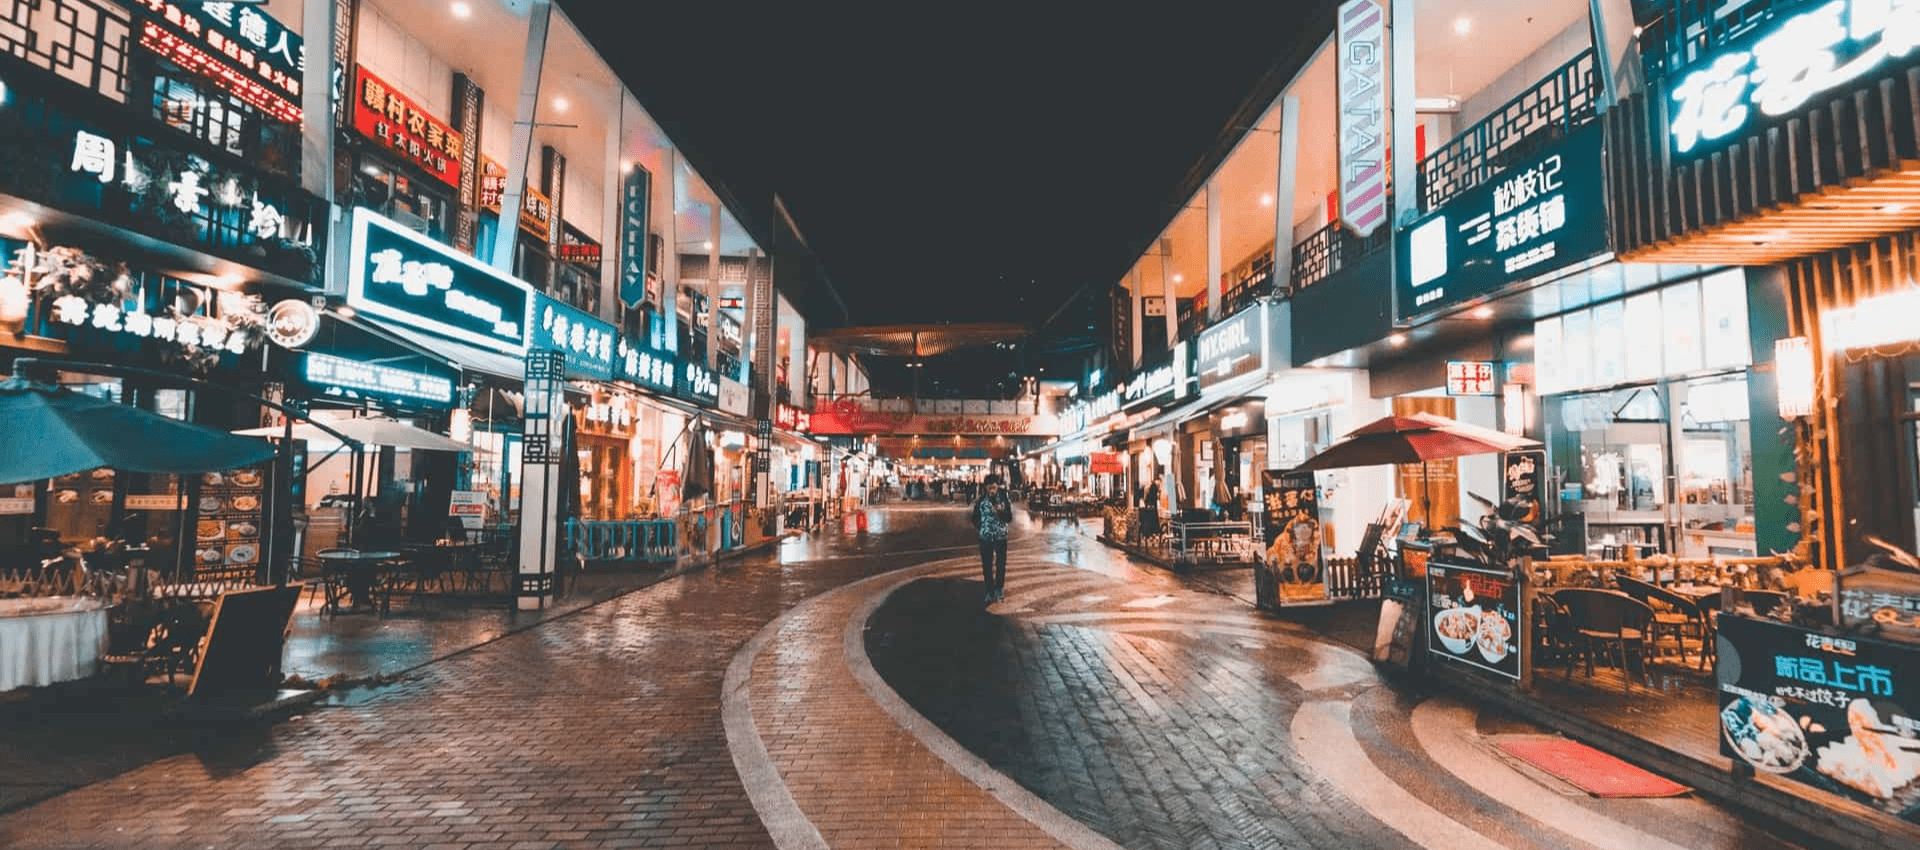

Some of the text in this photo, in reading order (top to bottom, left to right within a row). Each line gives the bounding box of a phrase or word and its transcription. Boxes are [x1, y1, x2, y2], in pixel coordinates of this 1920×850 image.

[1349, 40, 1377, 184] CATAL
[1493, 154, 1563, 217] 松枝记
[1774, 655, 1894, 697] 新品上市
